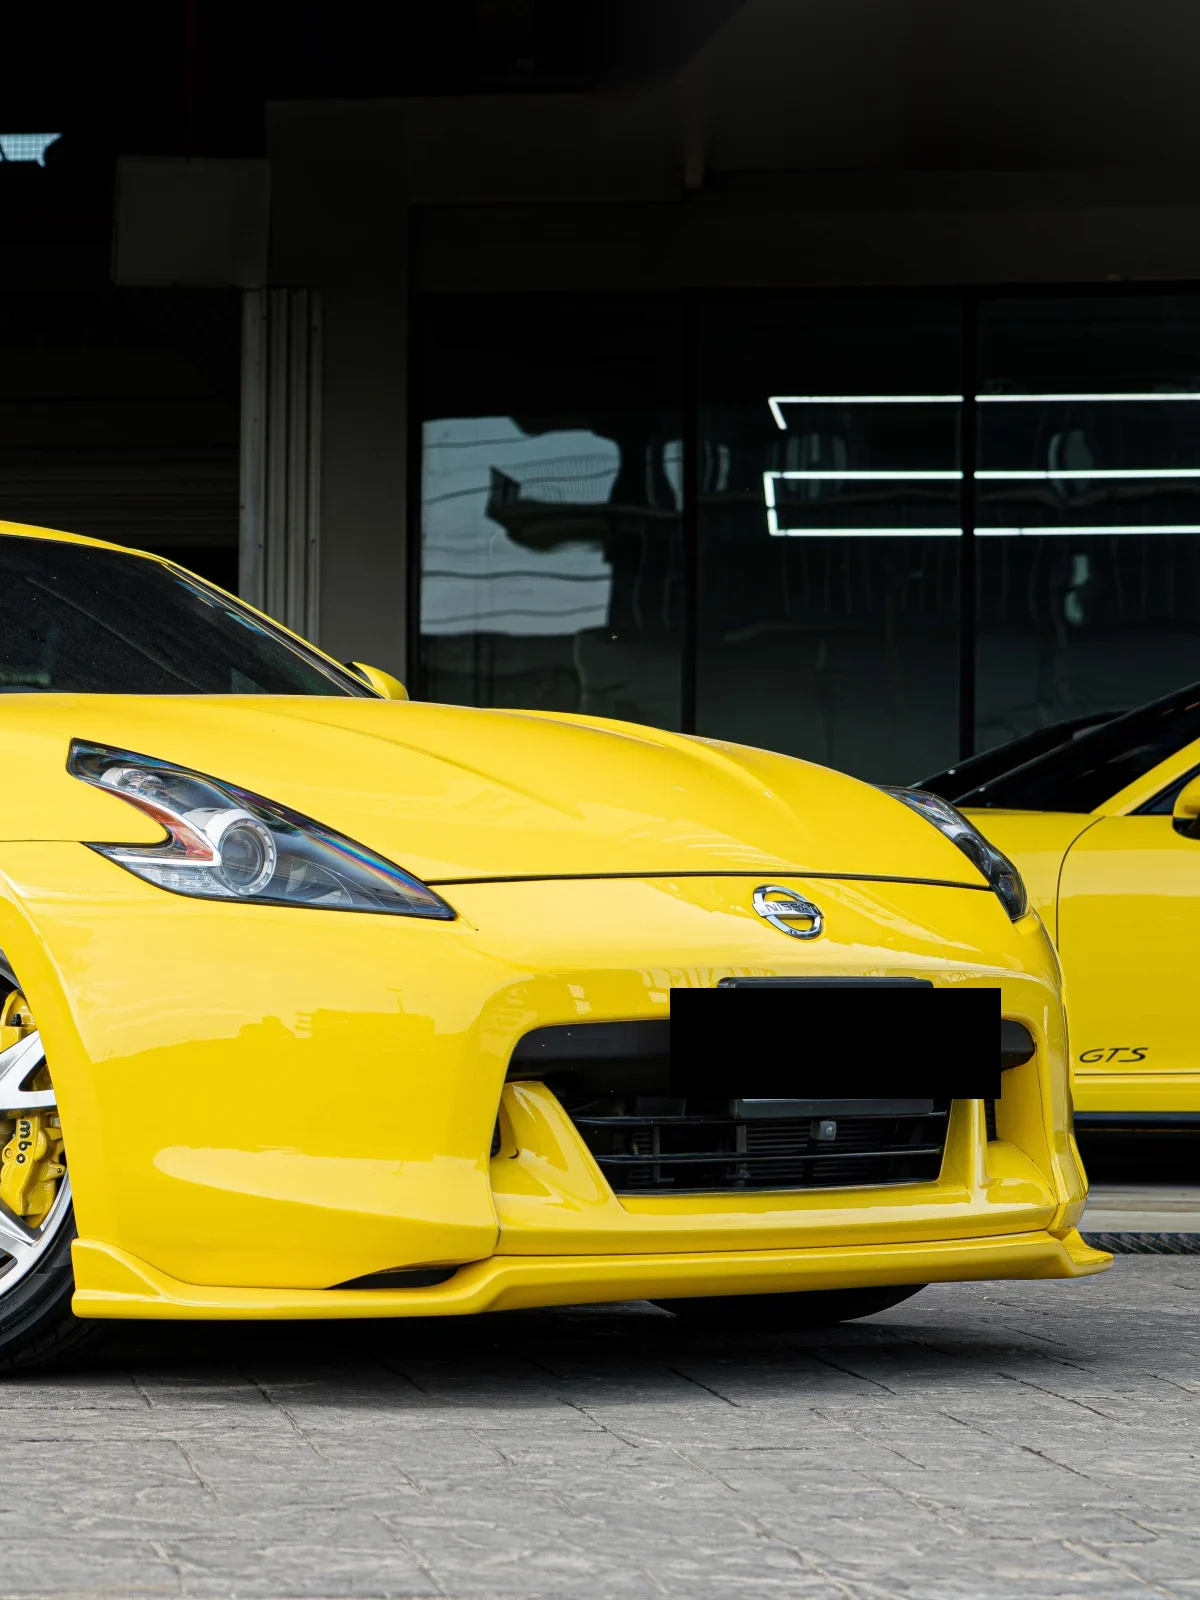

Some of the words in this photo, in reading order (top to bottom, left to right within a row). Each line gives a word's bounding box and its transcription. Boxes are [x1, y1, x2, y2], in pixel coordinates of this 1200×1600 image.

[765, 902, 821, 915] NISSAN
[1079, 1047, 1149, 1063] GTS
[16, 1120, 33, 1164] mbo
